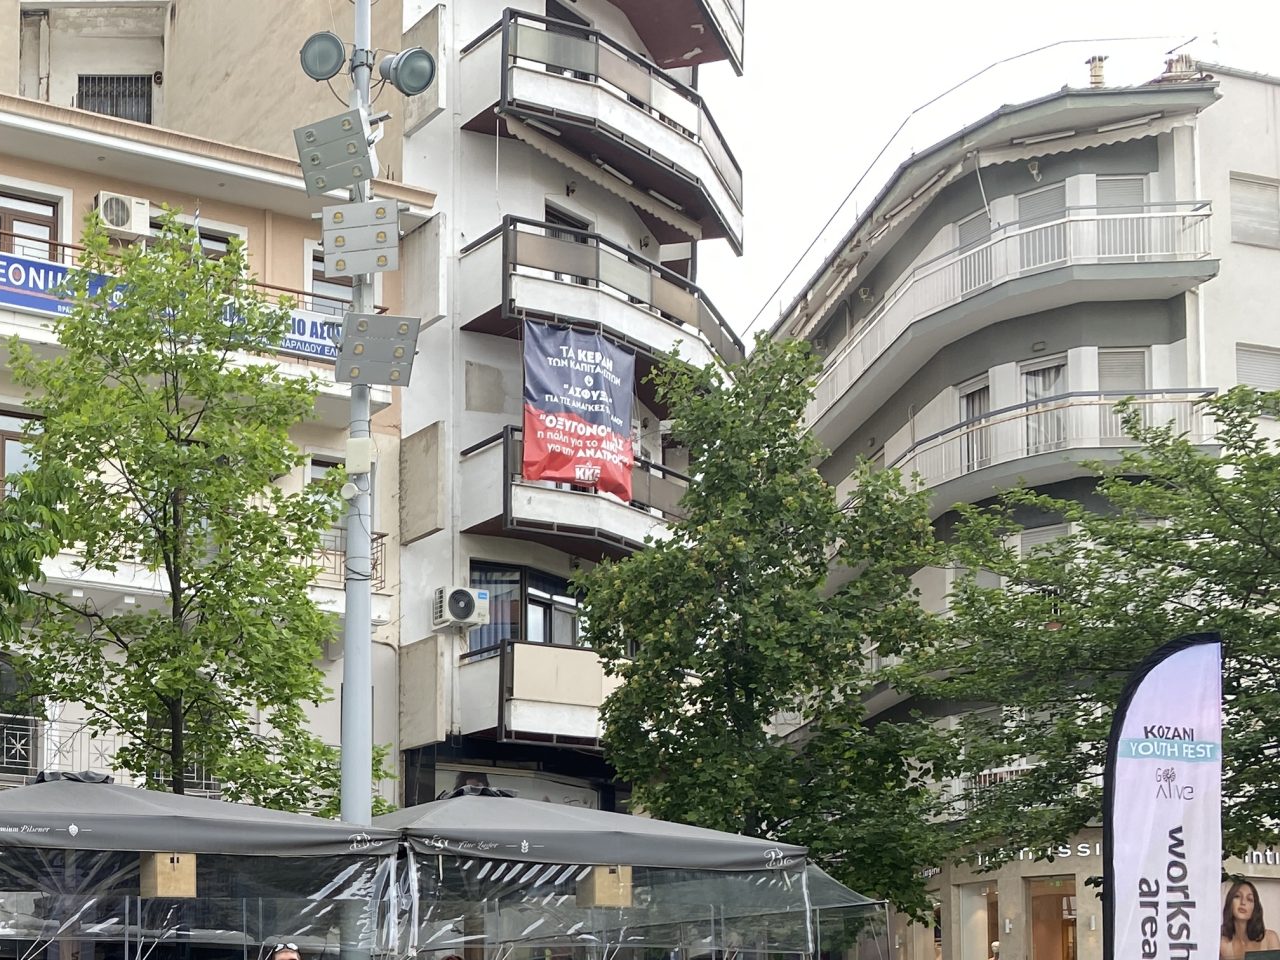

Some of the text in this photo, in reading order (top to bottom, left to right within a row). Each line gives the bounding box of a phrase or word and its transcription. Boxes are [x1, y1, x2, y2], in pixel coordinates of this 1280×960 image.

[560, 346, 576, 360] ΤΑ
[547, 357, 621, 386] ΤΩΝ ΚΑΠΙΤΑΙΣΤΩΝ
[575, 466, 601, 481] ΚΚΕ
[1144, 725, 1194, 742] KOZANI
[1130, 742, 1214, 758] YOUTH FEST
[1138, 877, 1160, 960] area
